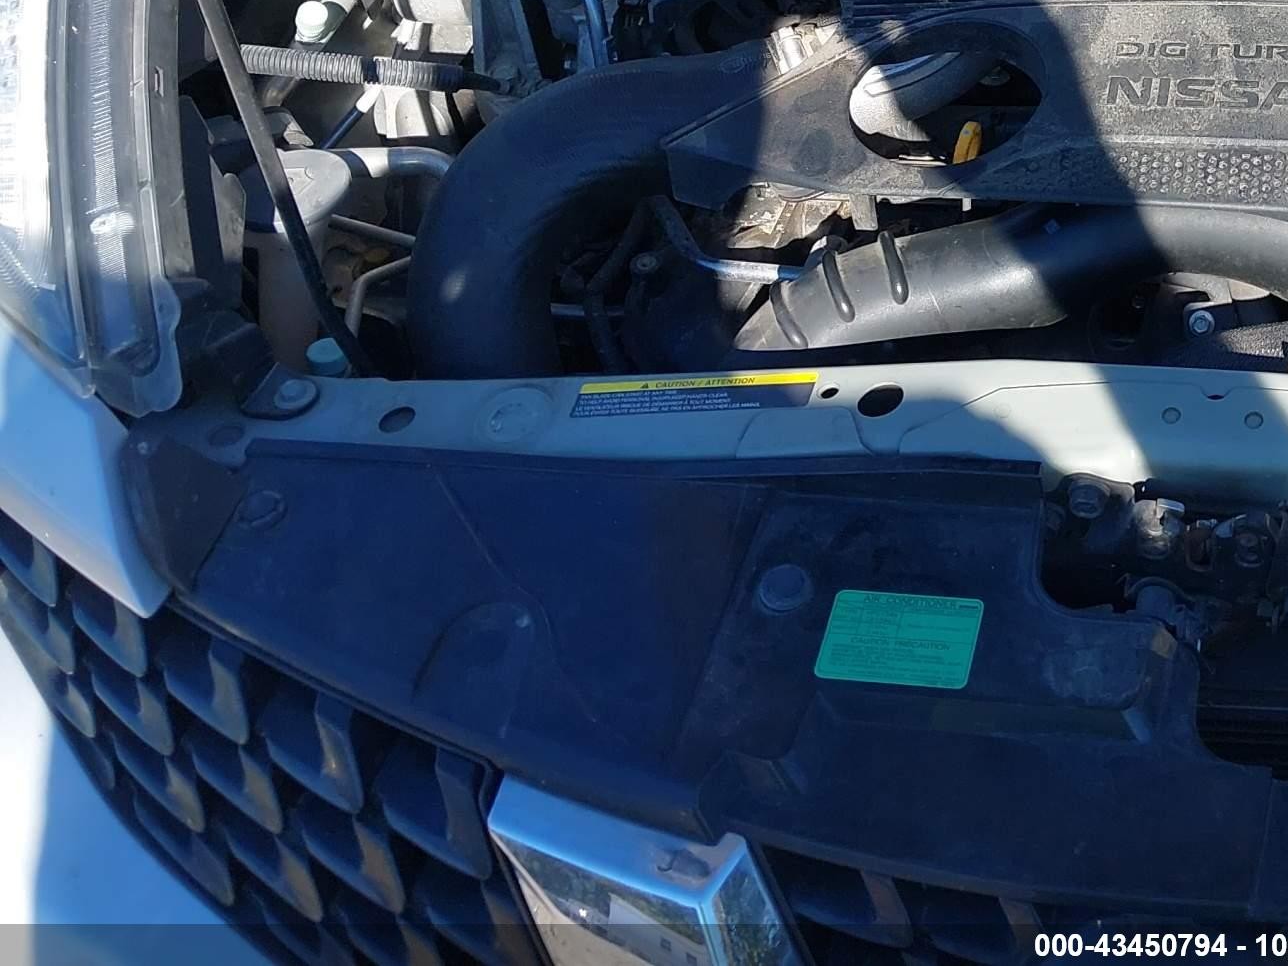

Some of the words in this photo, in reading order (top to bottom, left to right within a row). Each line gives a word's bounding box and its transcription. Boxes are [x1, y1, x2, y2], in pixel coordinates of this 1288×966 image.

[1115, 42, 1188, 58] DIG
[655, 380, 697, 388] CAUTION
[705, 377, 756, 387] ATTENTION
